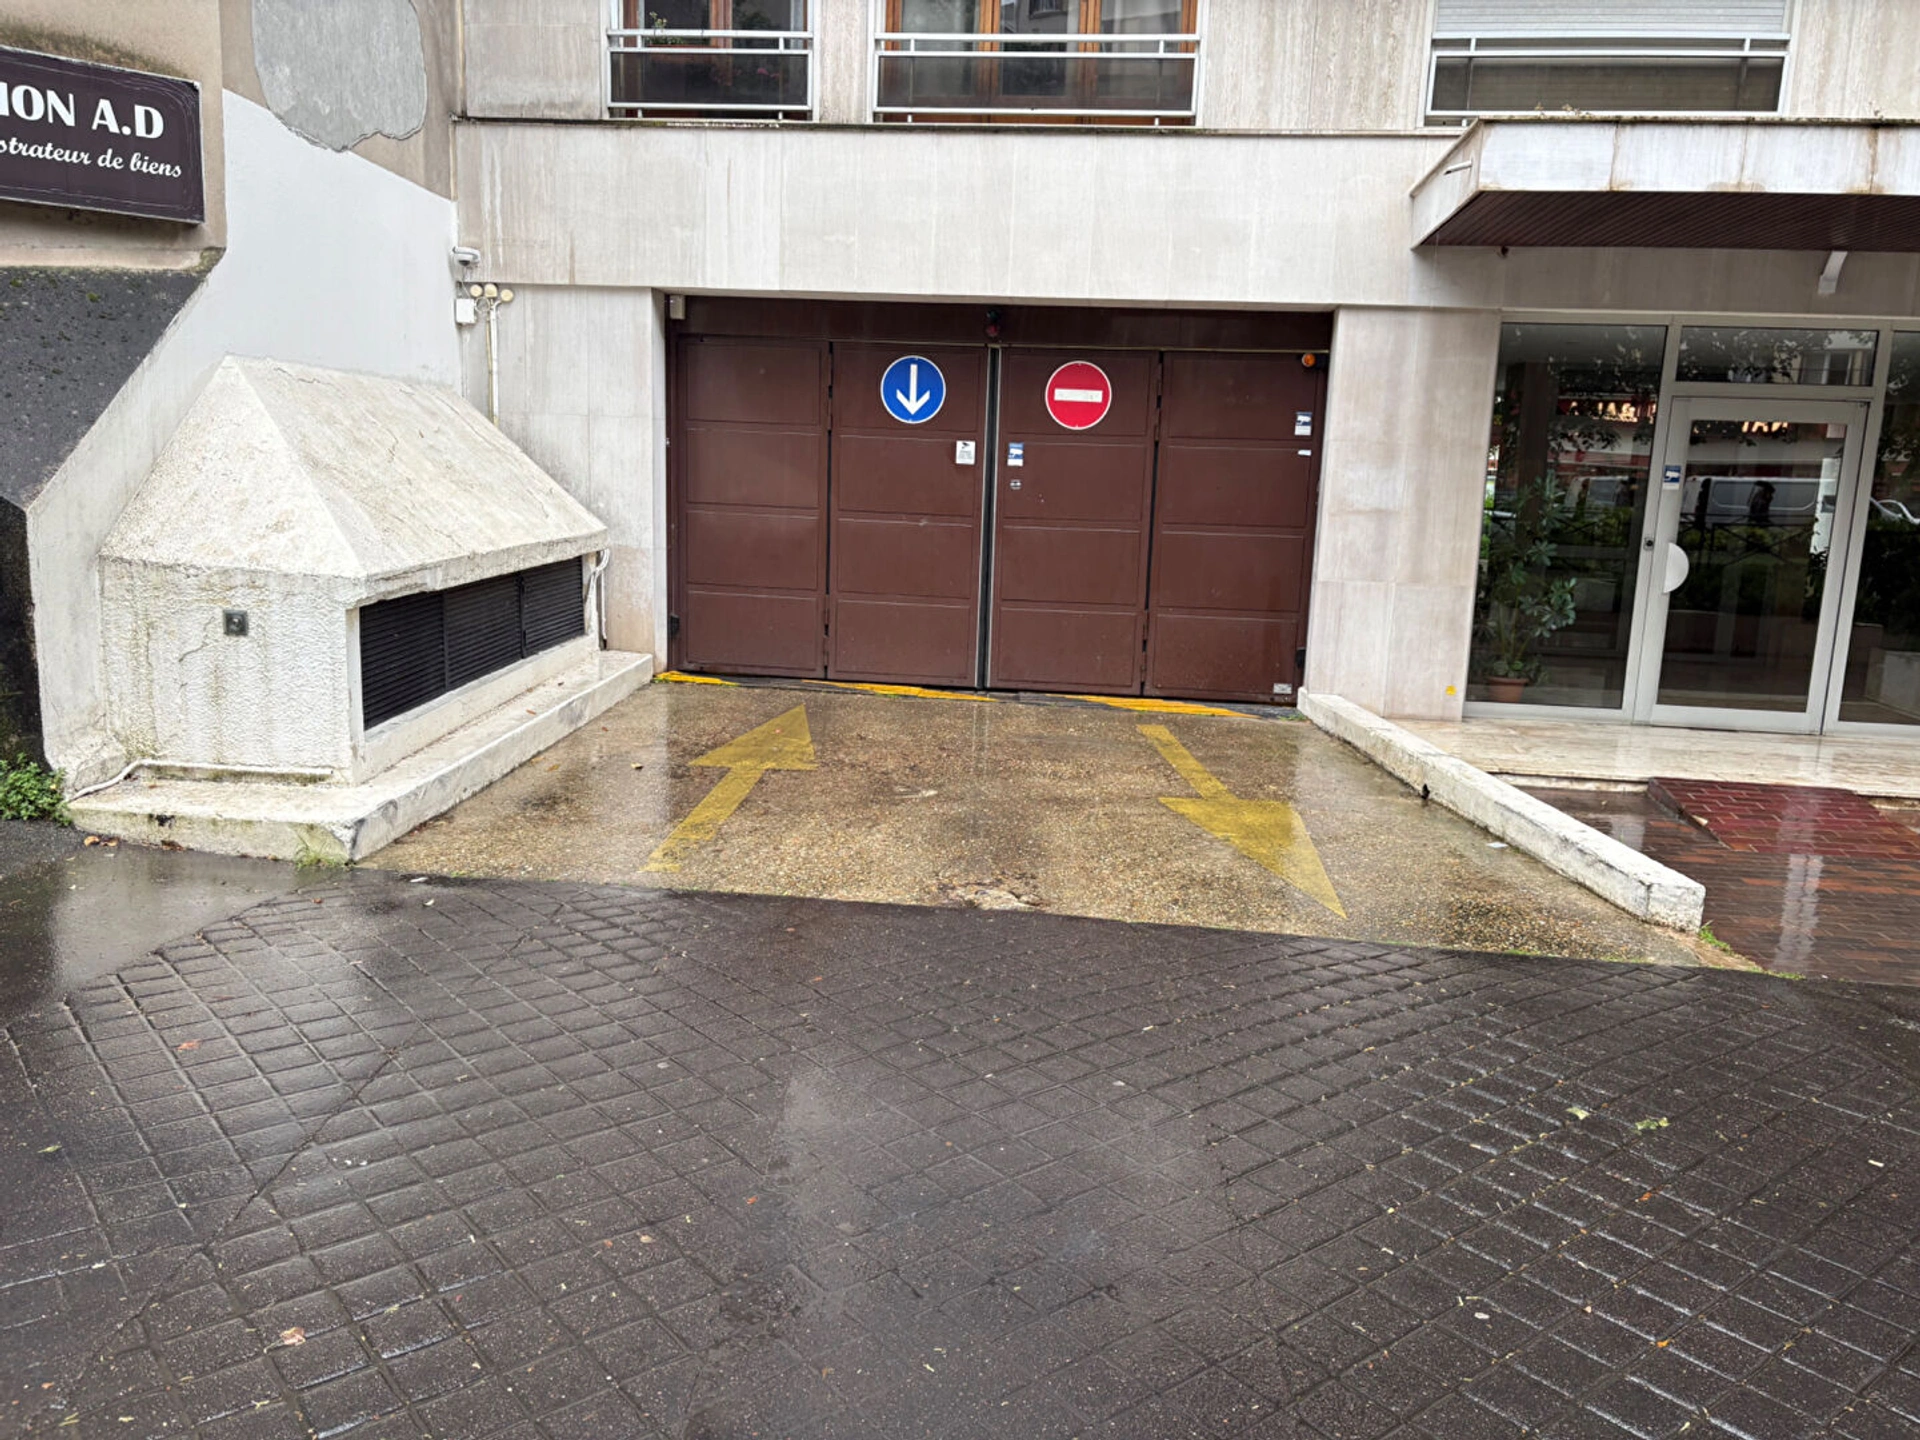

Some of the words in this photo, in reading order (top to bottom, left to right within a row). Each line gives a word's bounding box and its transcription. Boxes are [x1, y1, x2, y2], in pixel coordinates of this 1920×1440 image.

[91, 98, 164, 139] A.D
[97, 148, 124, 170] de
[129, 152, 182, 178] biens
